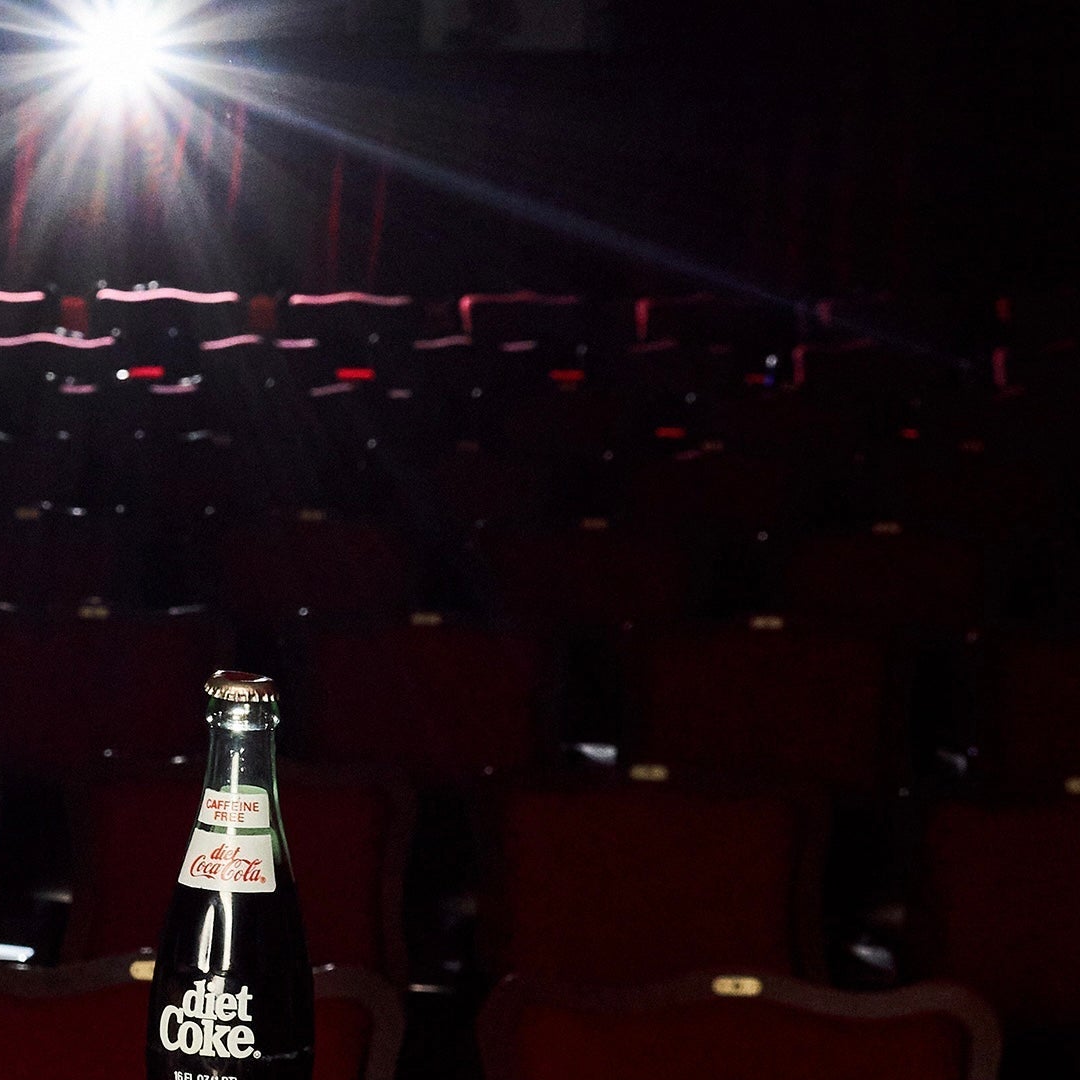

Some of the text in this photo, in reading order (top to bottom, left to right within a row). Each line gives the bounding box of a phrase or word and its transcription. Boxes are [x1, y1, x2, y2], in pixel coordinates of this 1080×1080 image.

[206, 798, 260, 812] CAFFEINE
[213, 811, 245, 822] FREE
[210, 843, 240, 861] diet
[182, 979, 253, 1022] diet
[160, 1004, 256, 1059] Coke
